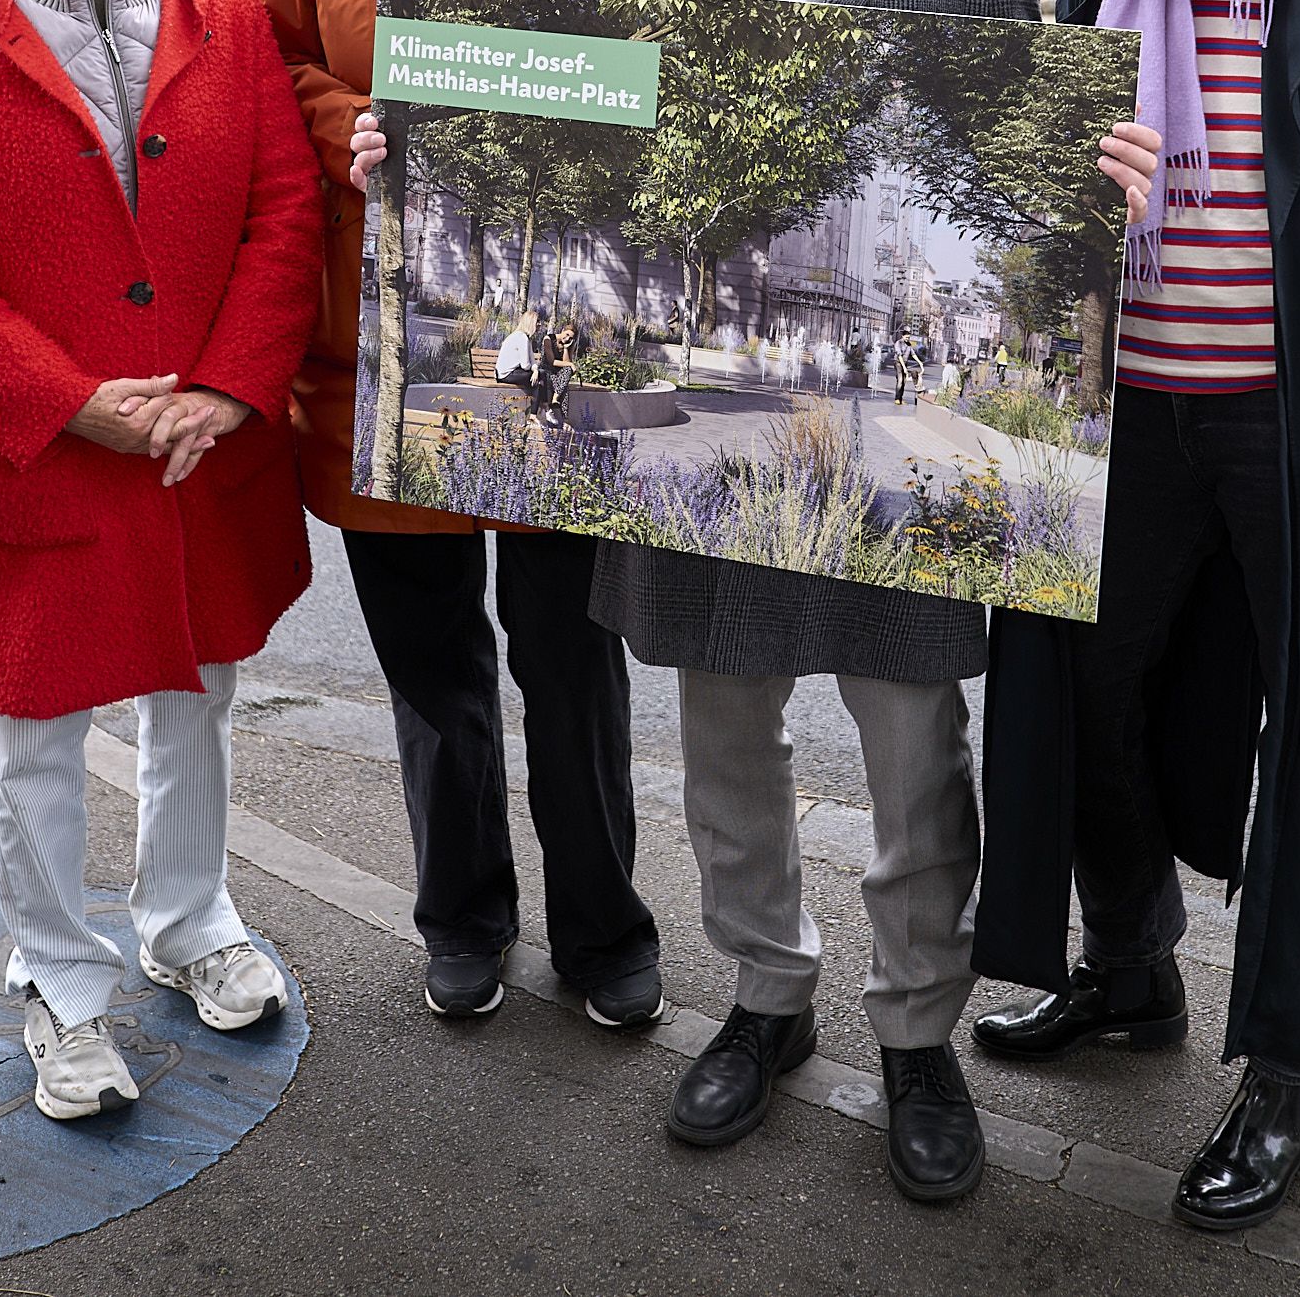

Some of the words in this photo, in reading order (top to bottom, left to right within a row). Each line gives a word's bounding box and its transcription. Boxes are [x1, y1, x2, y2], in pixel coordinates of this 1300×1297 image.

[390, 35, 515, 68] Klimafitter
[520, 48, 594, 75] Josef-
[388, 63, 641, 110] Matthias-Hauer-Platz
